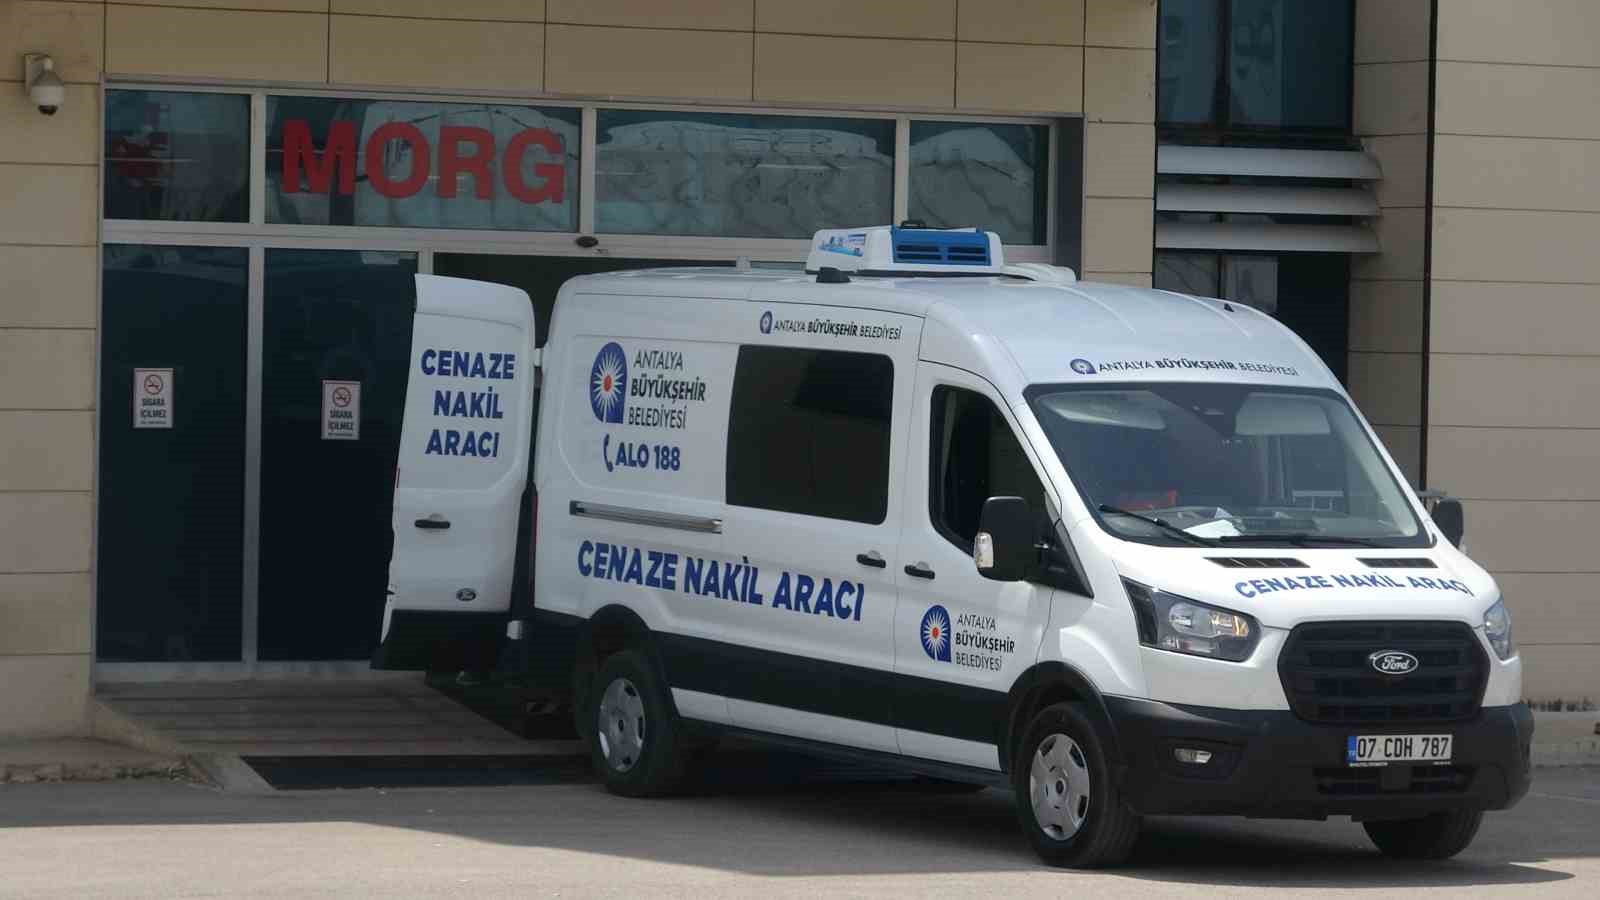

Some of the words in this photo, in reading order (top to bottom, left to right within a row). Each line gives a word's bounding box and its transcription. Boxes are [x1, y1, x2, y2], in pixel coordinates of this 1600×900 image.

[281, 119, 566, 204] MORG
[774, 319, 806, 332] ANTALYA
[807, 318, 858, 337] BÜYÜKŞEHİR
[421, 348, 516, 380] CENAZE
[633, 349, 684, 371] ANTALYA
[1099, 359, 1155, 372] ANTALYA
[1155, 358, 1238, 370] BÜYÜKŞEHİR
[630, 373, 706, 404] BÜYÜKŞEHİR
[433, 386, 504, 419] NAKİL
[628, 404, 687, 430] BELEDİYESİ
[425, 428, 500, 457] ARACI
[615, 442, 649, 468] ALO
[654, 445, 681, 471] 188
[577, 540, 679, 591] CENAZE
[683, 555, 764, 605] NAKİL
[772, 571, 865, 621] ARACI
[1235, 575, 1333, 598] CENAZE
[1331, 573, 1406, 588] NAKİL
[957, 614, 997, 630] ANTALYA
[1381, 655, 1410, 670] Ford
[1357, 738, 1377, 758] 07
[1384, 738, 1413, 757] CDH
[1421, 737, 1449, 757] 787
